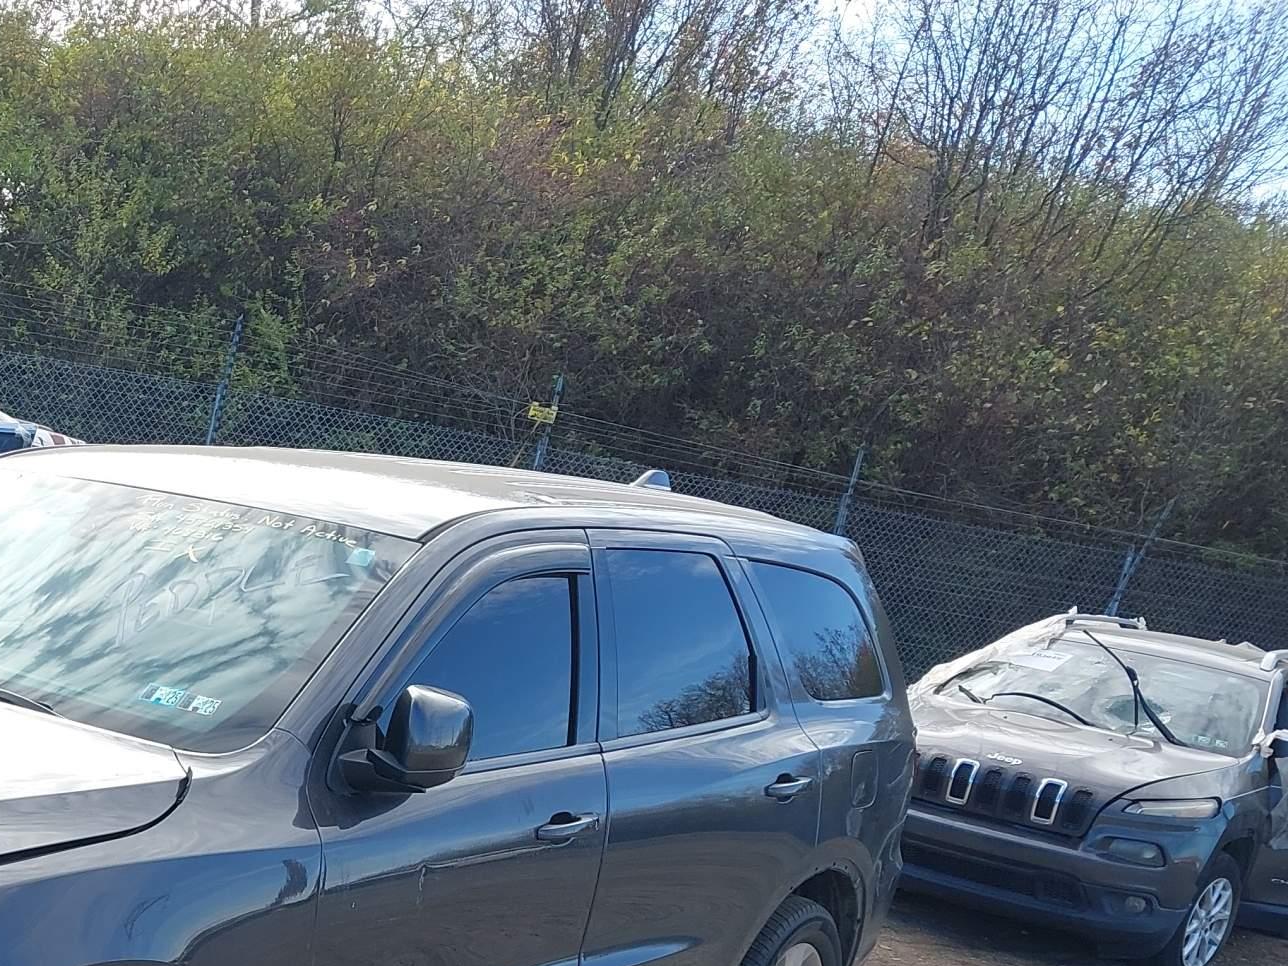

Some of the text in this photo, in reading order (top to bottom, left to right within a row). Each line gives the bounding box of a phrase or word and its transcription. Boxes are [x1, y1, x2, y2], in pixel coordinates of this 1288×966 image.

[257, 515, 294, 531] Not
[300, 525, 358, 549] Active
[986, 752, 1023, 766] Jeep
